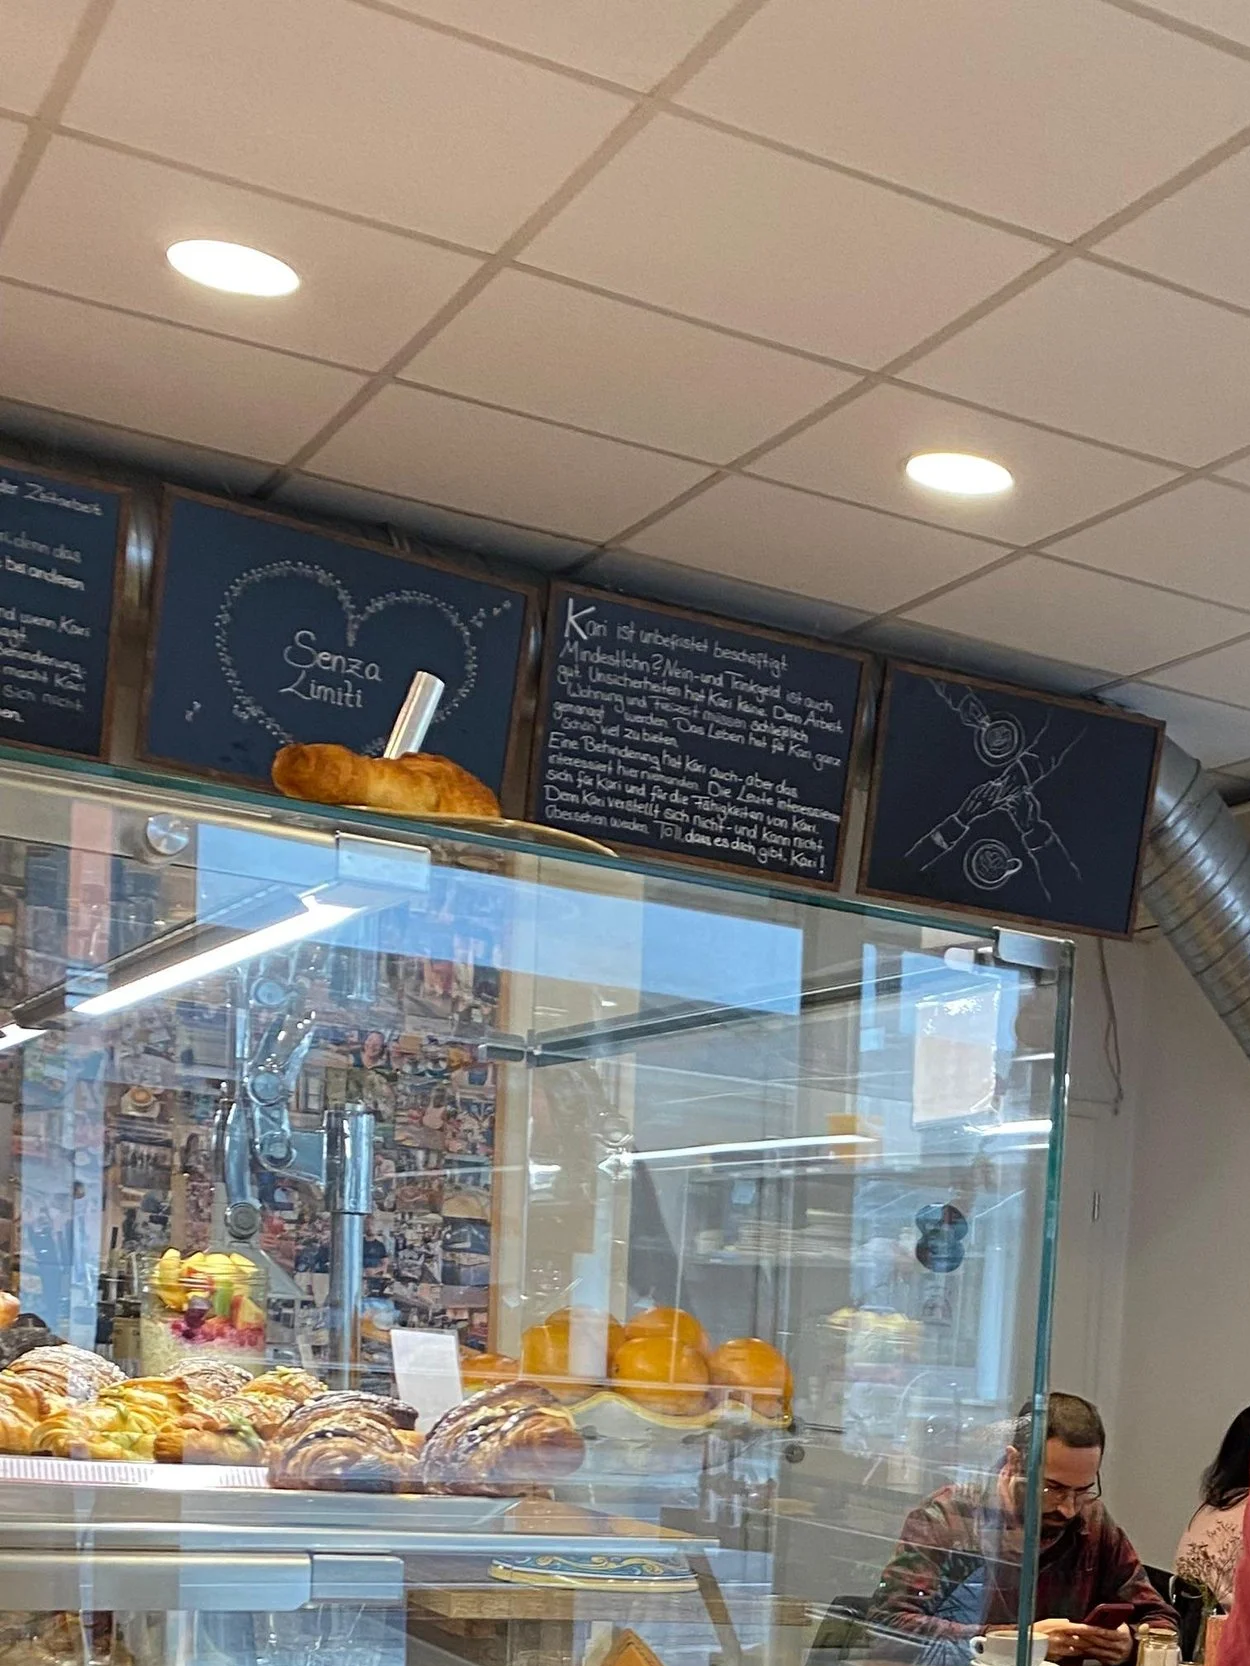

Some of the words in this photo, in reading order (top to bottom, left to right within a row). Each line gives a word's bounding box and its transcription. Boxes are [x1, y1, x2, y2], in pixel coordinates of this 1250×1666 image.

[564, 598, 608, 640] Kari
[616, 621, 636, 642] ist
[640, 629, 708, 652] unbefristet
[283, 630, 382, 681] Senza
[559, 640, 663, 675] Mindestlohn?
[724, 670, 780, 702] Trinkgeld
[803, 697, 833, 712] auch
[278, 669, 363, 708] Limiti
[567, 682, 624, 713] Wohnung
[626, 695, 647, 708] und
[648, 695, 699, 718] Freizeit
[588, 665, 681, 697] Unsicherheiten
[684, 684, 706, 702] hat
[708, 688, 732, 709] Kari
[772, 705, 802, 724] Denn
[600, 724, 620, 737] viel
[623, 728, 640, 740] zu
[672, 717, 705, 735] Das
[708, 723, 745, 744] Leben
[749, 732, 767, 748] hat
[788, 741, 812, 760] Kari
[813, 753, 841, 771] ganz
[548, 732, 579, 750] Eine
[580, 735, 661, 771] Behinderung
[662, 749, 682, 769] hat
[685, 755, 706, 773] Kari
[745, 772, 774, 790] aber
[775, 779, 798, 798] das
[548, 753, 613, 775] interessiert
[616, 759, 640, 778] hier
[708, 780, 731, 798] Die
[737, 785, 774, 806] Leute
[544, 785, 579, 804] Denn
[582, 790, 605, 808] Kari
[607, 796, 660, 818] verstellt
[663, 808, 689, 822] sich
[734, 824, 758, 839] und
[793, 837, 824, 852] nicht
[546, 769, 573, 782] sich
[577, 770, 594, 788] für
[596, 774, 621, 791] Kari
[625, 784, 646, 797] und
[650, 785, 668, 801] für
[669, 789, 688, 804] die
[690, 795, 764, 821] Fähigkeiten
[766, 815, 788, 829] von
[685, 828, 712, 846] dass
[713, 837, 729, 848] es
[731, 837, 757, 855] dich
